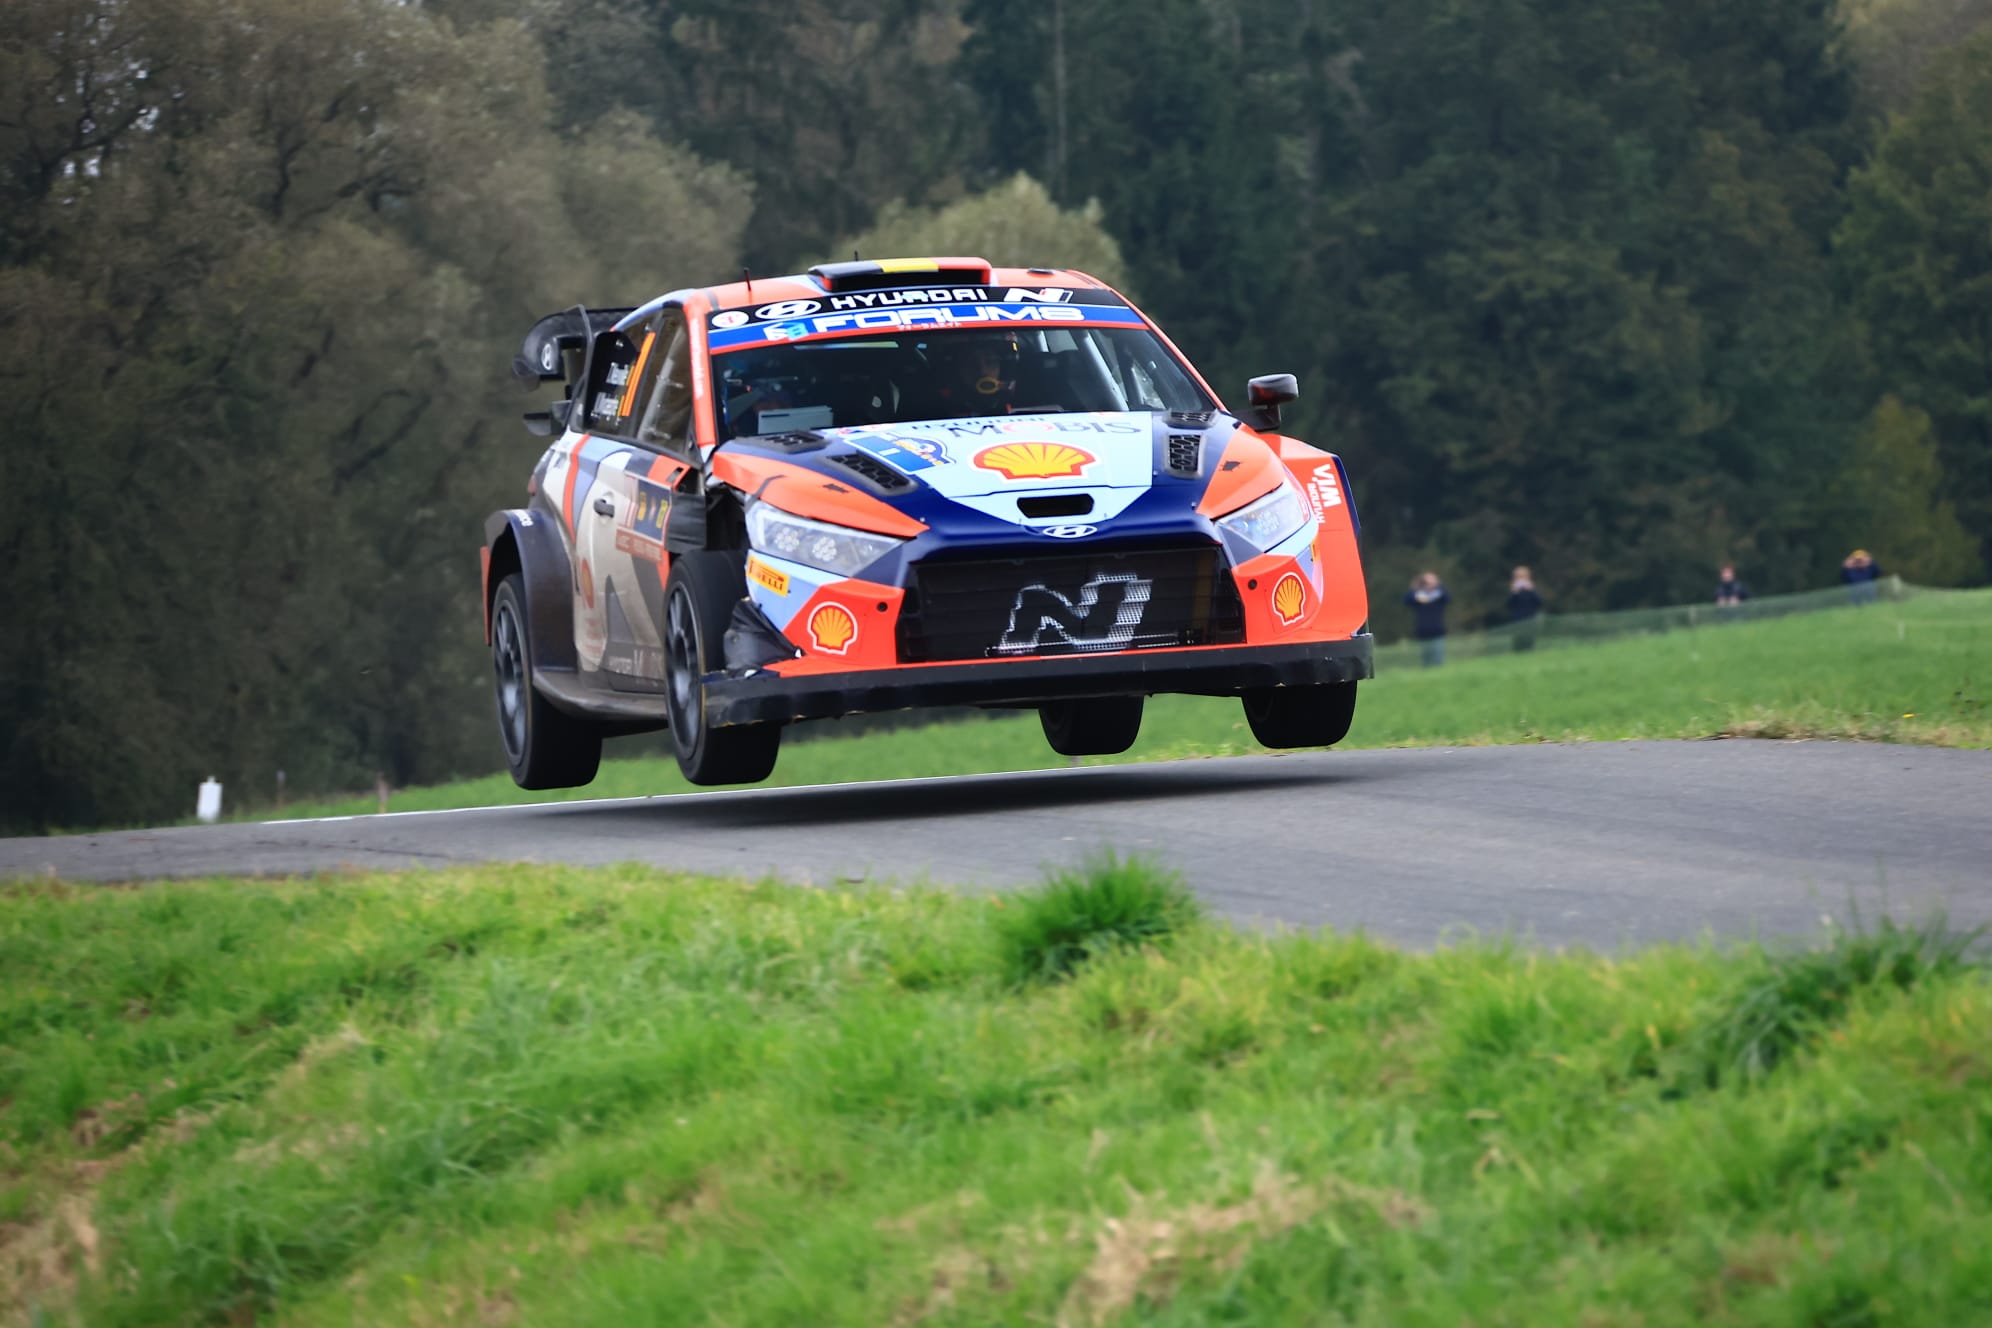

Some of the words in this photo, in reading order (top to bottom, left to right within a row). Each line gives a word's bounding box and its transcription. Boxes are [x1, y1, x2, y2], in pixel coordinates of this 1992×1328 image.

[830, 287, 988, 310] HYUNDAI
[812, 305, 1086, 334] FORUM8
[947, 420, 1143, 438] MOBIS
